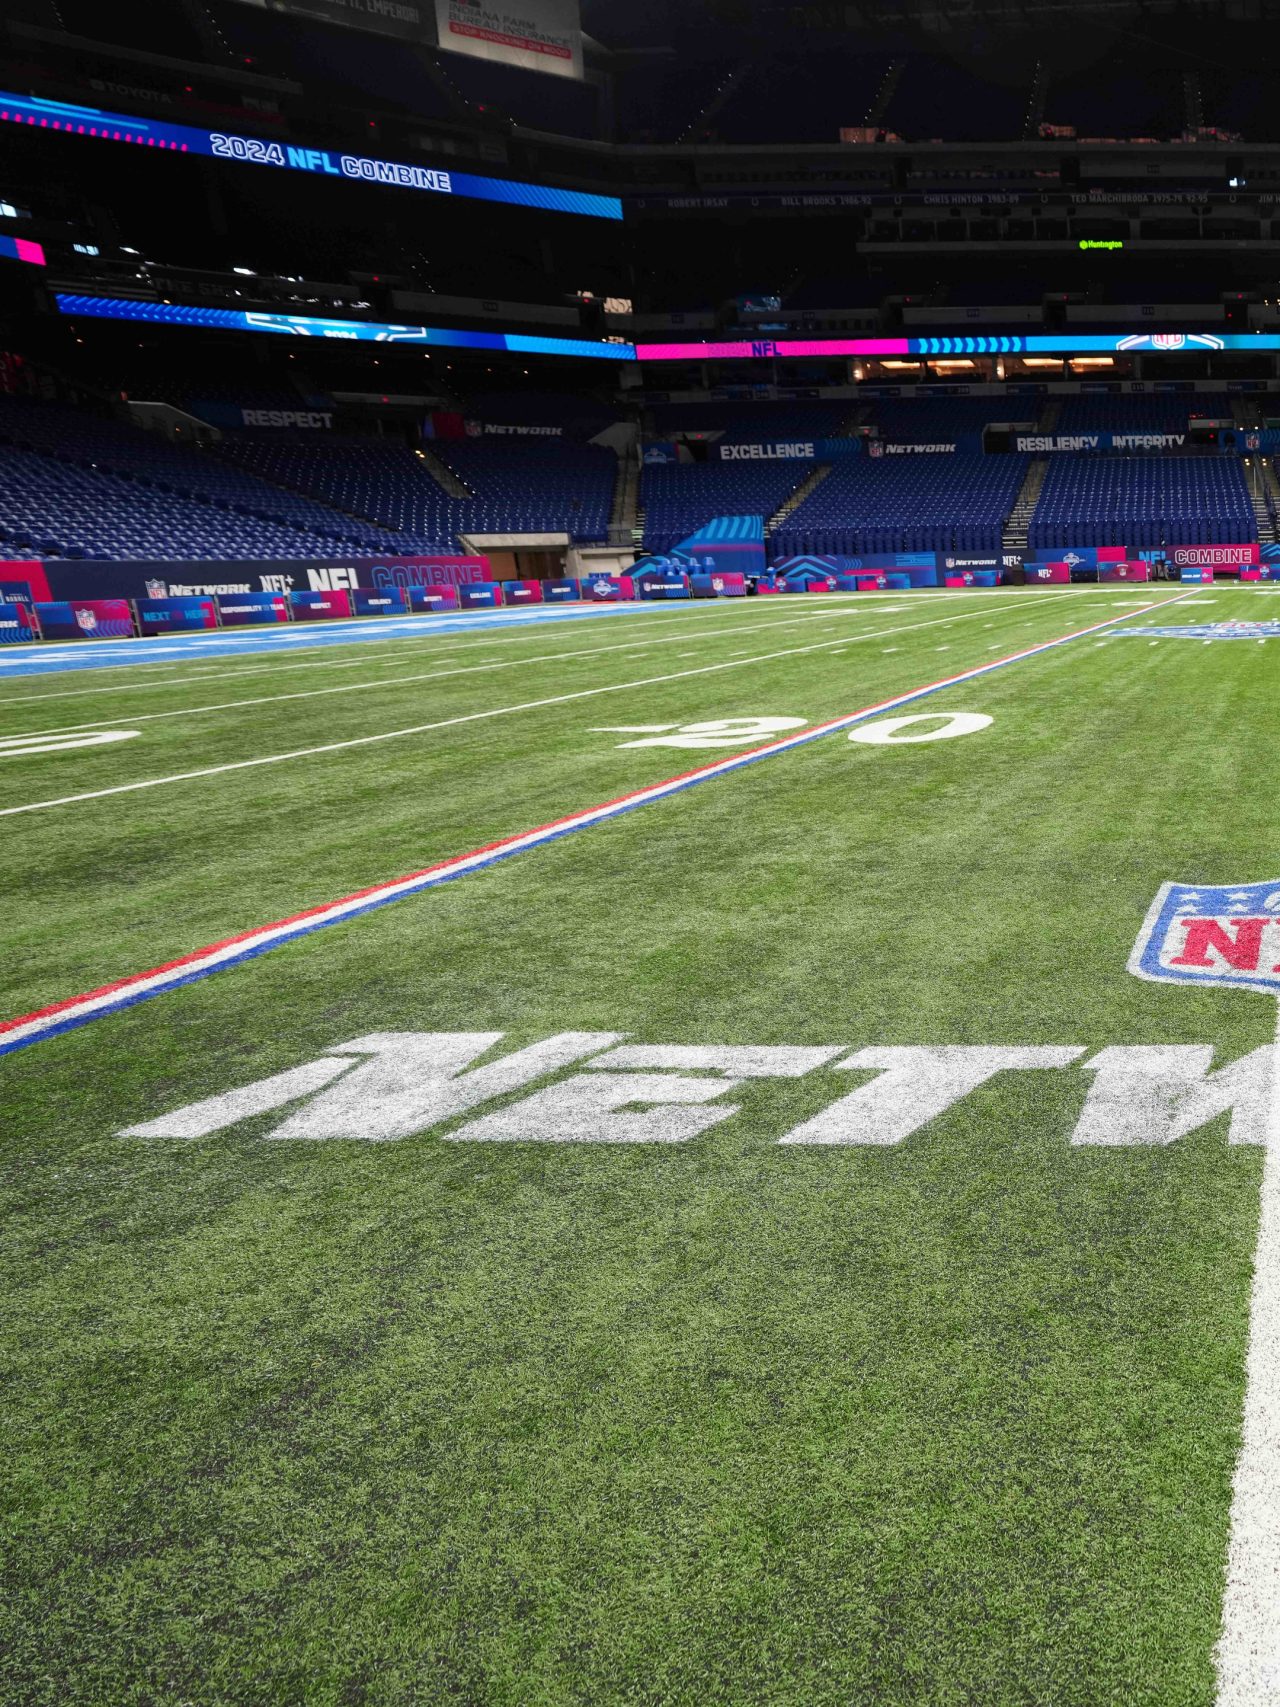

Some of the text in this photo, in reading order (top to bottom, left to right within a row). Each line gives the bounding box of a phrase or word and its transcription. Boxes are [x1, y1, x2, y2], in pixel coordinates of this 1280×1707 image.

[448, 3, 537, 31] INDIANA FARM
[448, 12, 570, 46] BUREAU INSURANCE
[106, 83, 173, 104] TOYOTA
[209, 133, 452, 193] 2024 NFL COMBINE
[668, 198, 729, 207] ROBERT IRSAY
[924, 195, 950, 204] CHRIS
[951, 195, 984, 204] HINTON
[1071, 194, 1087, 203] TED
[1258, 194, 1272, 203] JIM
[1088, 240, 1123, 249] Huntington
[751, 341, 783, 357] NFL
[242, 409, 333, 429] RESPECT
[484, 423, 563, 436] NETWORK
[885, 443, 956, 454] NETWORK
[1016, 434, 1186, 453] RESILIENCY INTEGRITY
[719, 443, 815, 460] EXCELLENCE
[1002, 554, 1022, 567] NFL+
[1138, 548, 1252, 565] NFL COMBINE
[1037, 567, 1053, 578] NFL+
[168, 583, 251, 597] NETWORK
[258, 574, 295, 597] NFL+
[371, 564, 484, 589] COMBINE
[143, 611, 170, 622] NEXT
[184, 609, 211, 620] HERE
